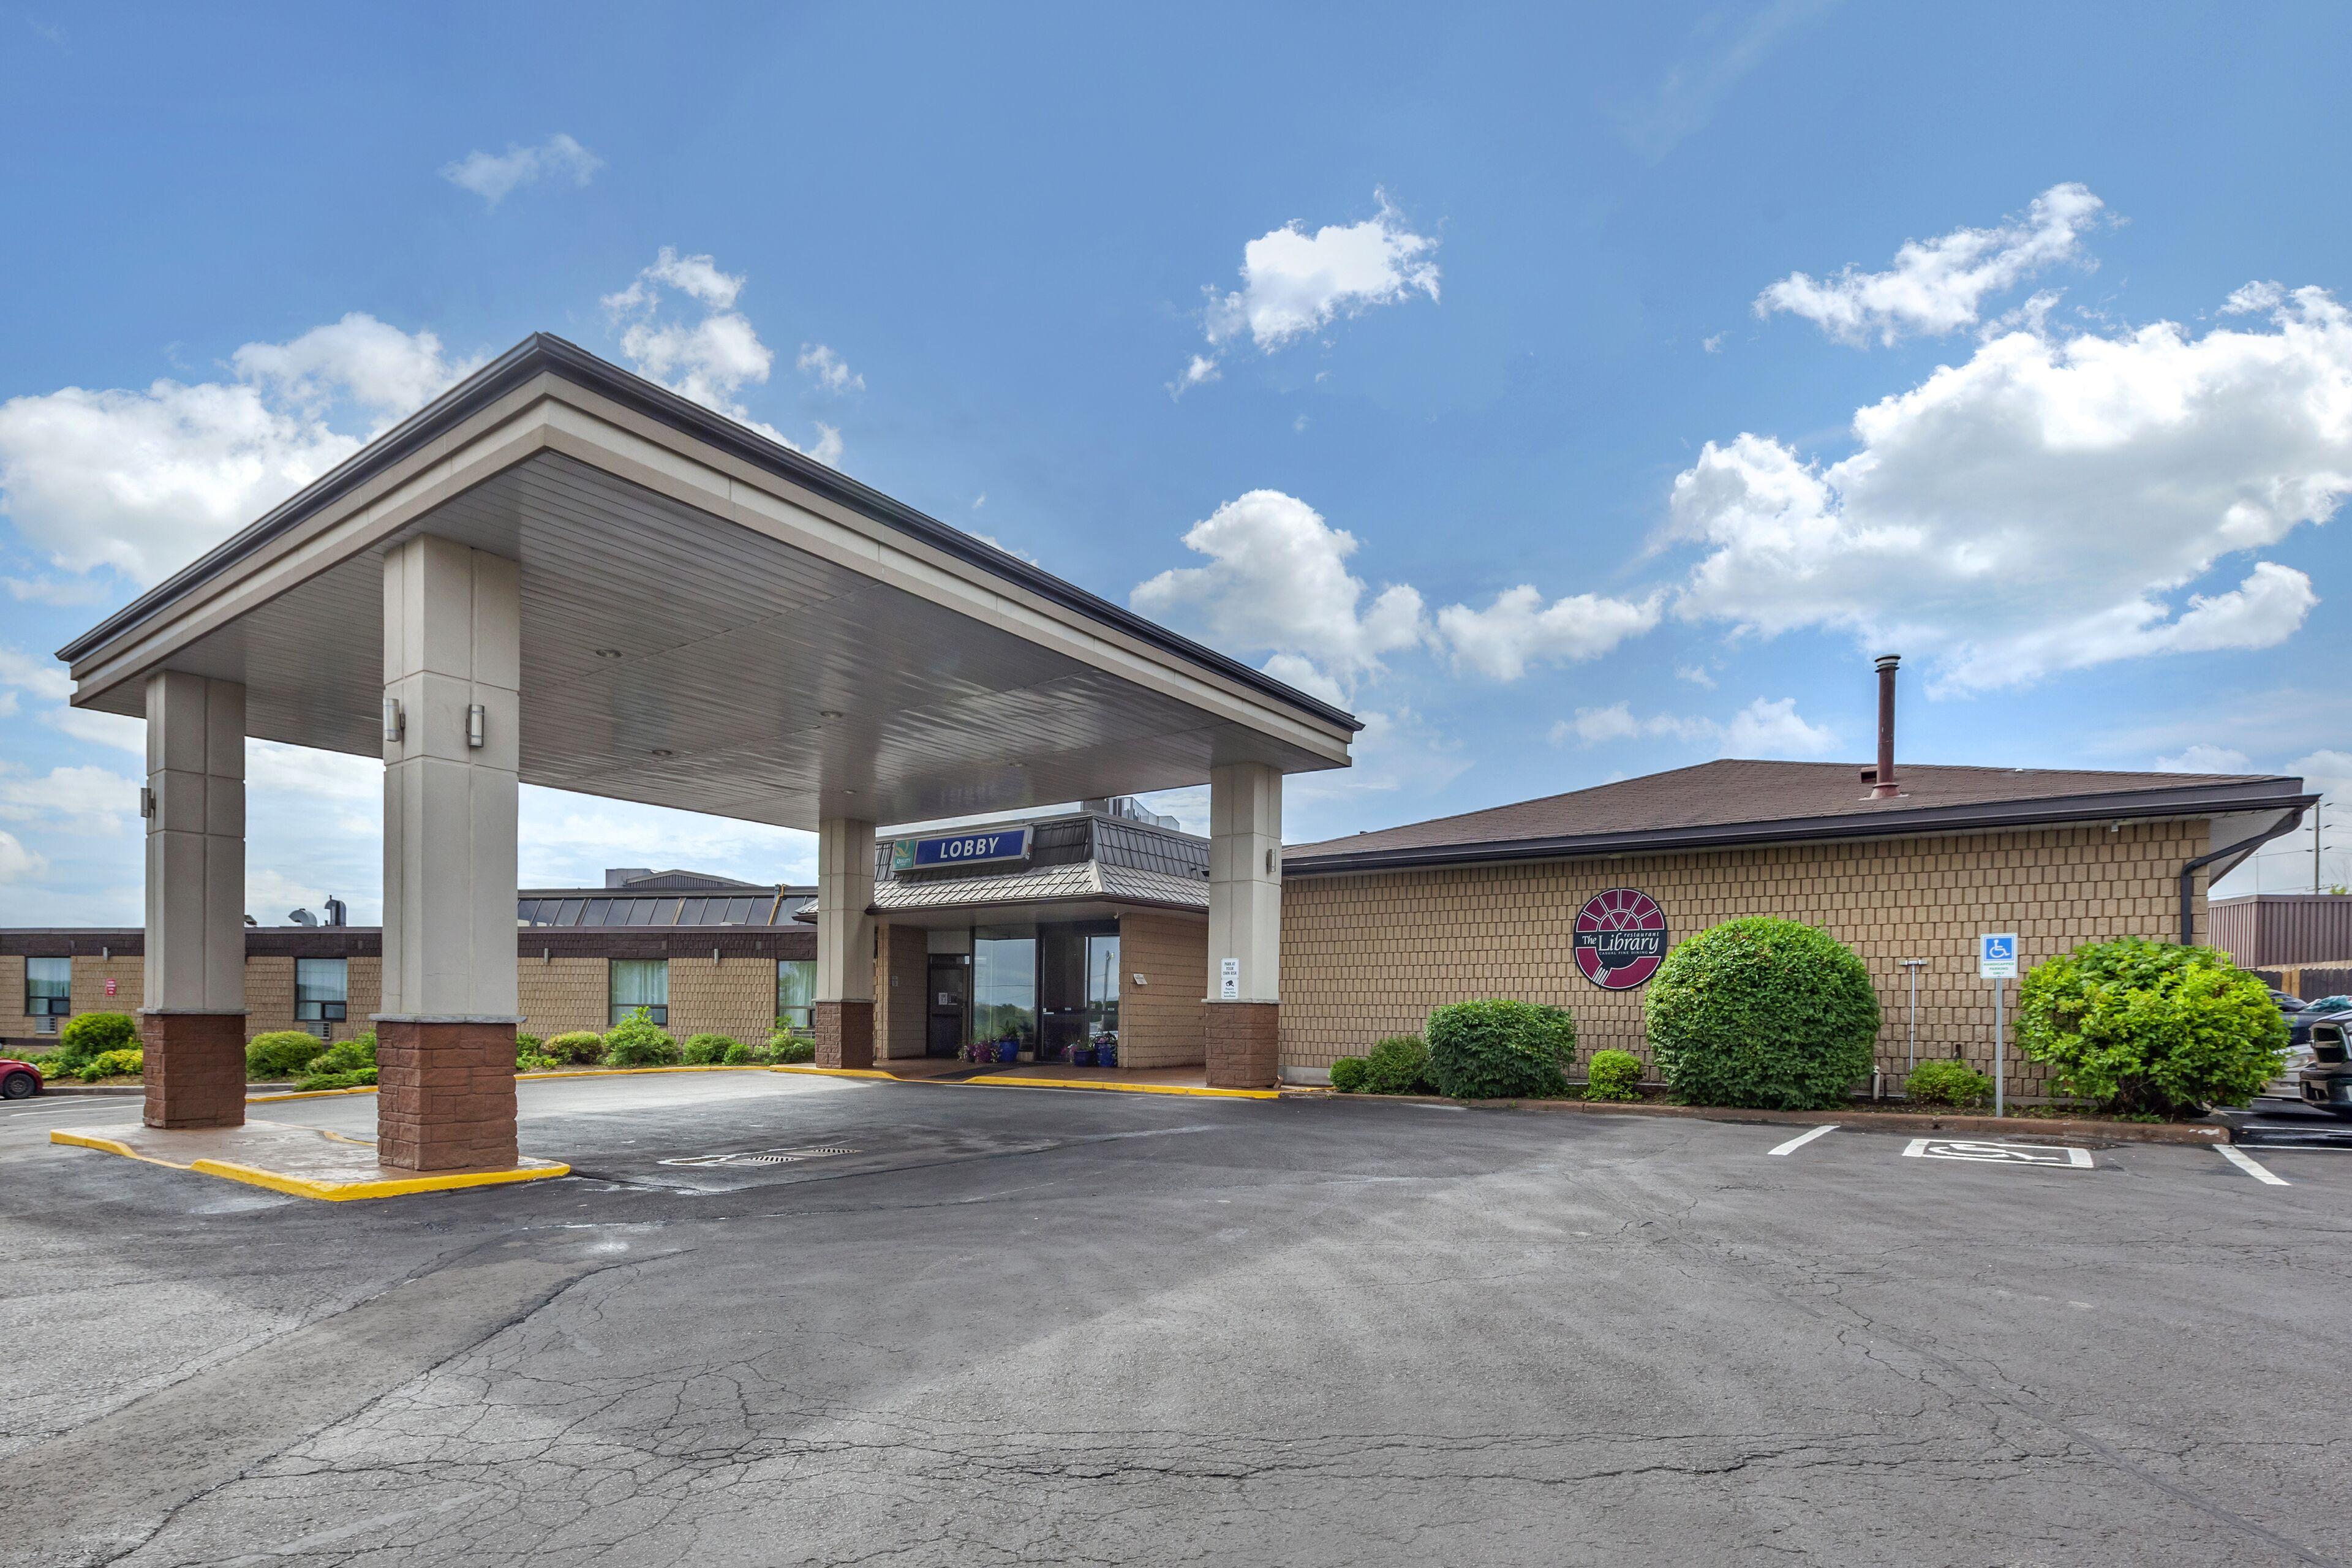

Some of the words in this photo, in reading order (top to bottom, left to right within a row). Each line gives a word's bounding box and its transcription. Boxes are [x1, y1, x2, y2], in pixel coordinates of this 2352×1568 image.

[940, 837, 1000, 859] LOBBY
[1582, 935, 1597, 944] The
[1598, 932, 1659, 954] Library
